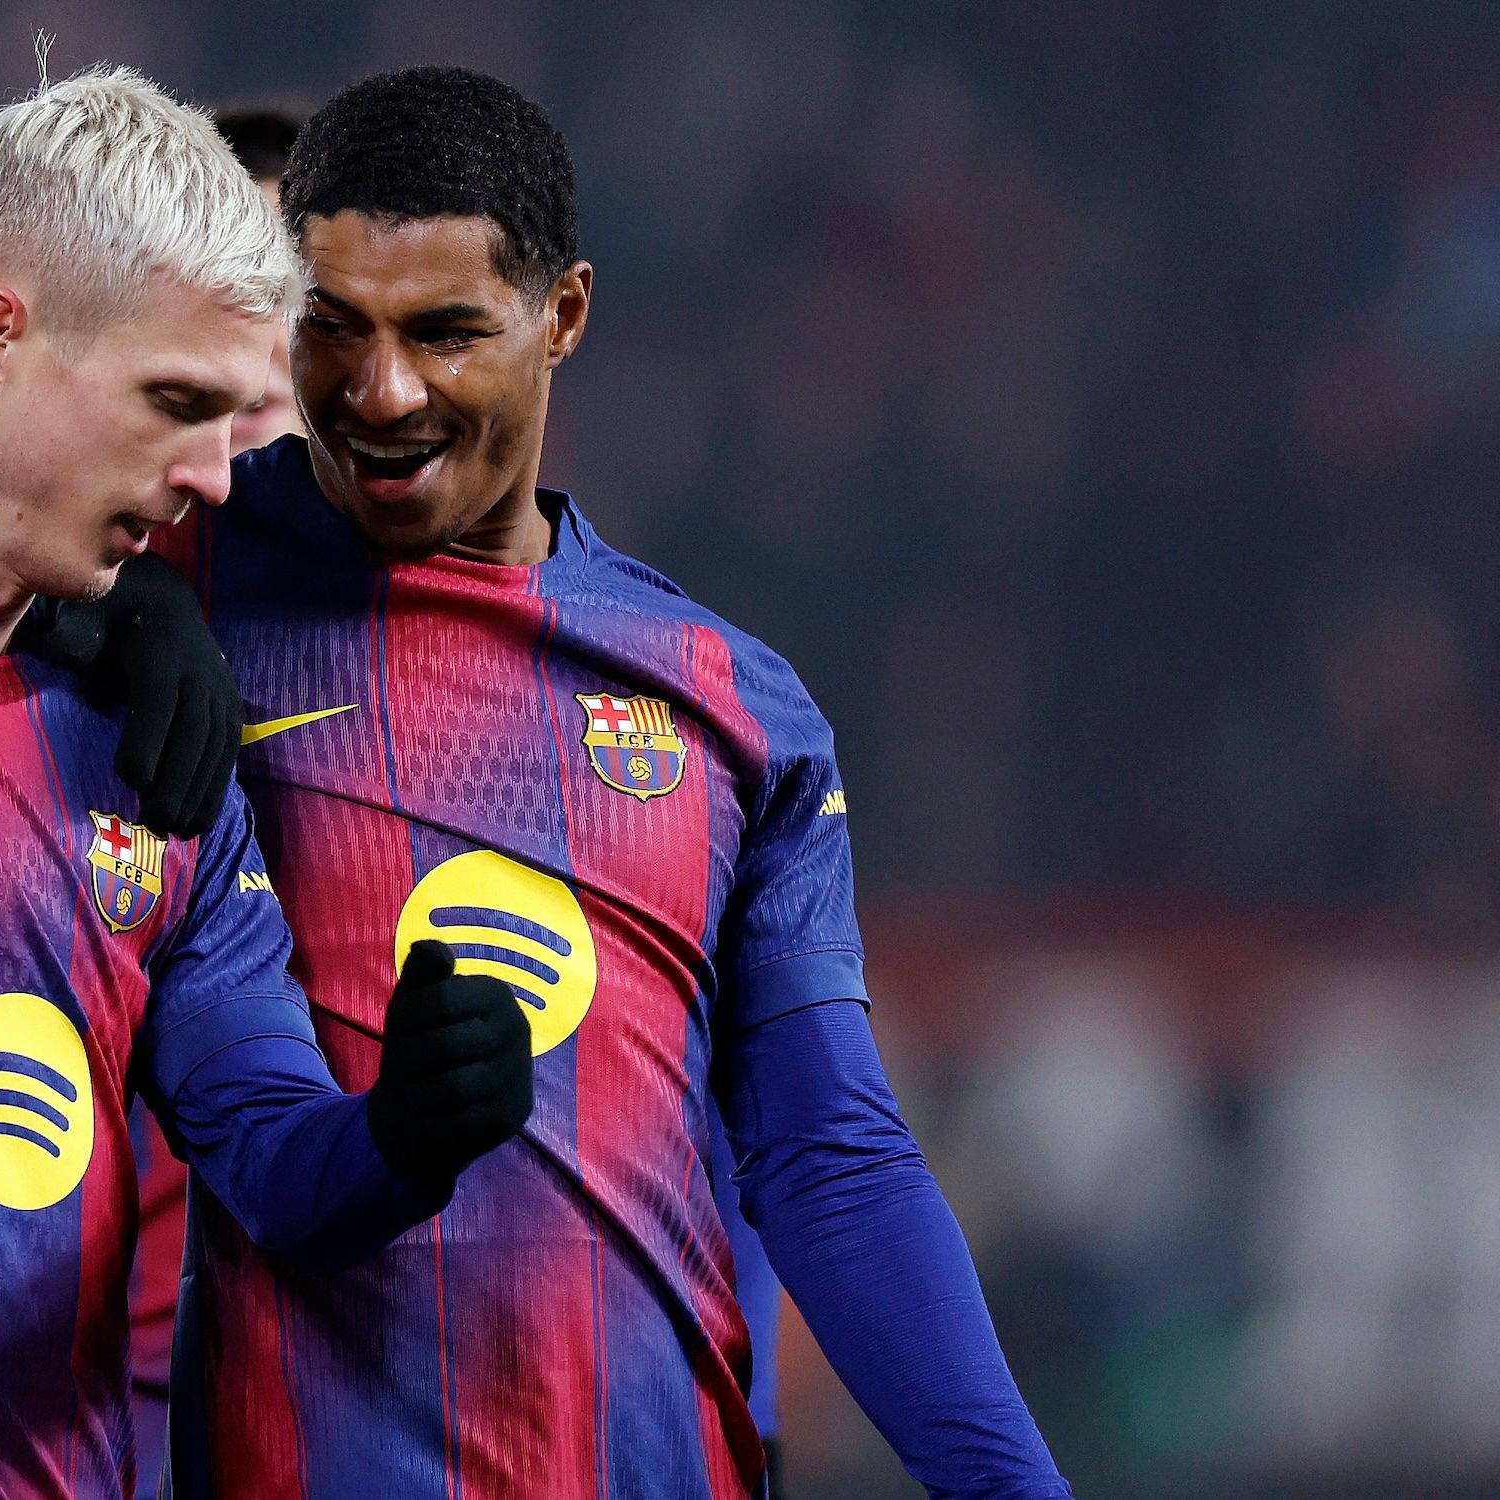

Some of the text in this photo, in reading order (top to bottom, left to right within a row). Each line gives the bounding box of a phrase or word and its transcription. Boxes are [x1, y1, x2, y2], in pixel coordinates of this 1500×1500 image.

[615, 733, 654, 749] FCB
[115, 861, 143, 884] FCB
[238, 870, 279, 902] AM
